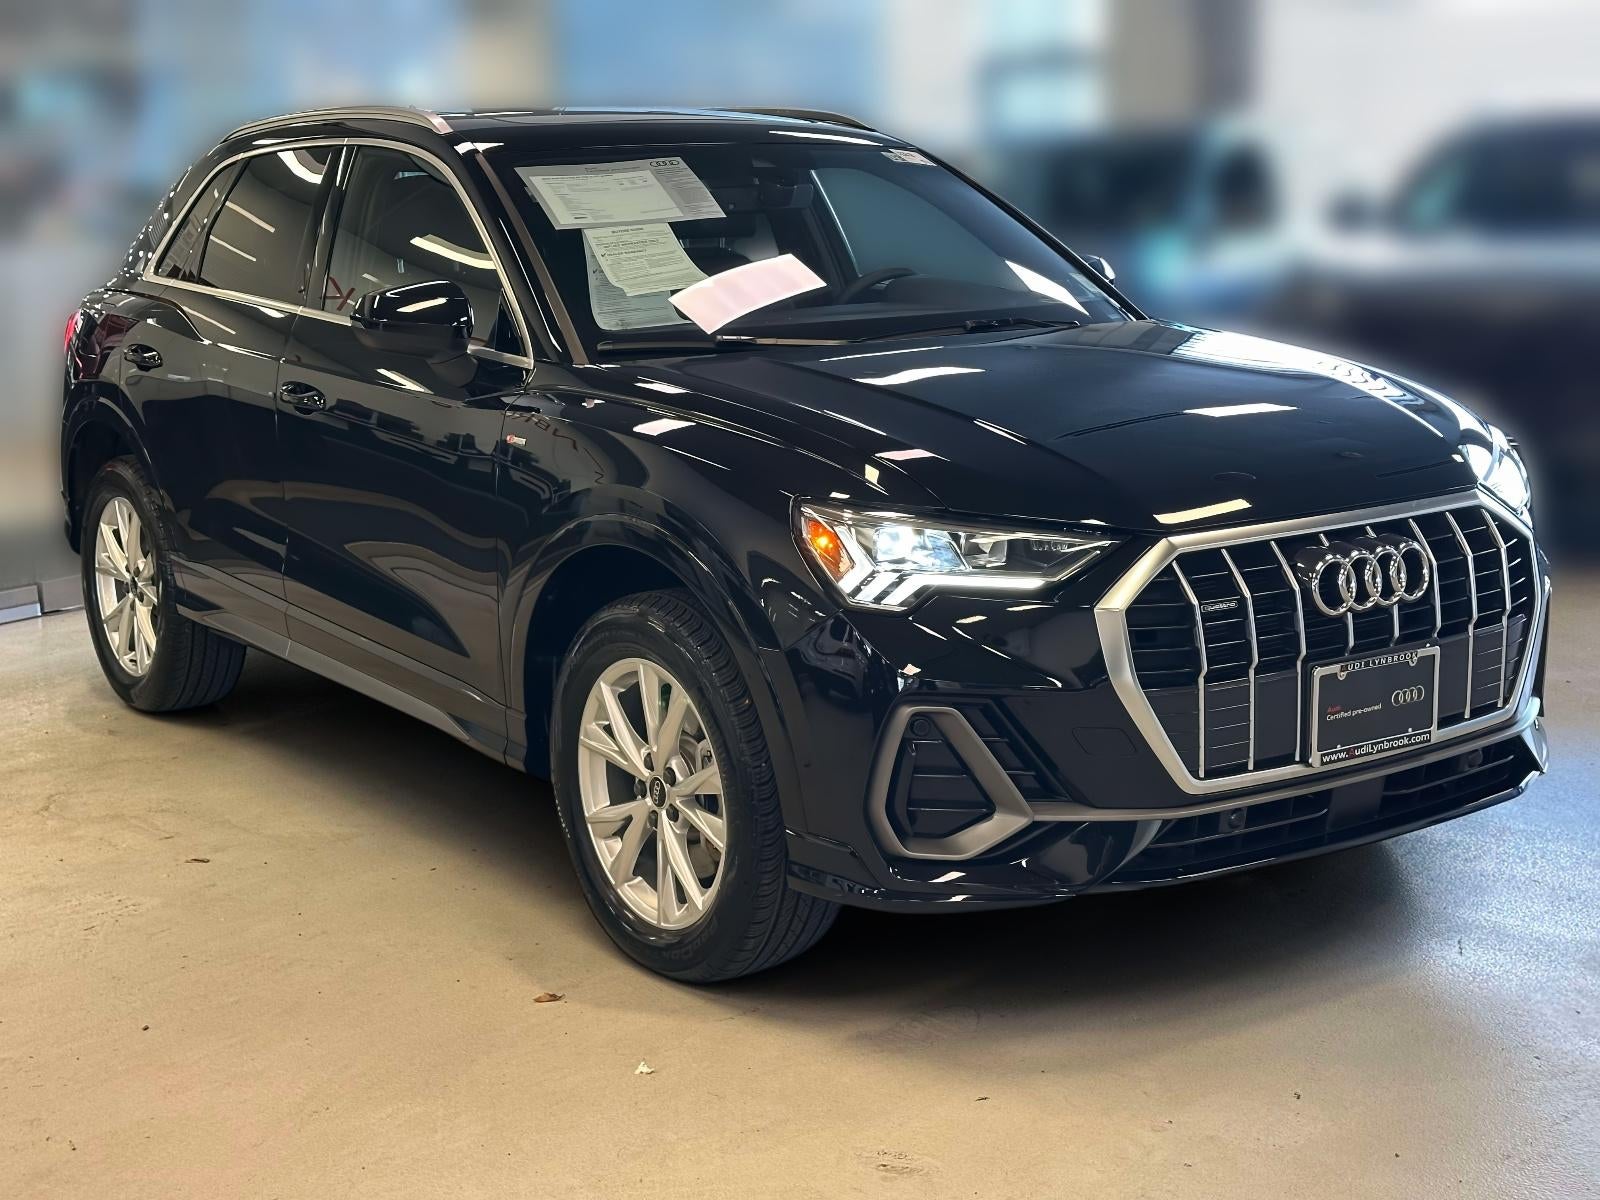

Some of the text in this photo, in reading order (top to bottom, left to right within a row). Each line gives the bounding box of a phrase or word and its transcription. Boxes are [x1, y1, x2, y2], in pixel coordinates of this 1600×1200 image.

[1369, 652, 1417, 665] LYNBROOK
[1326, 702, 1381, 720] Certified pre-owned
[1322, 734, 1430, 763] www.AudiLynbrook.com
